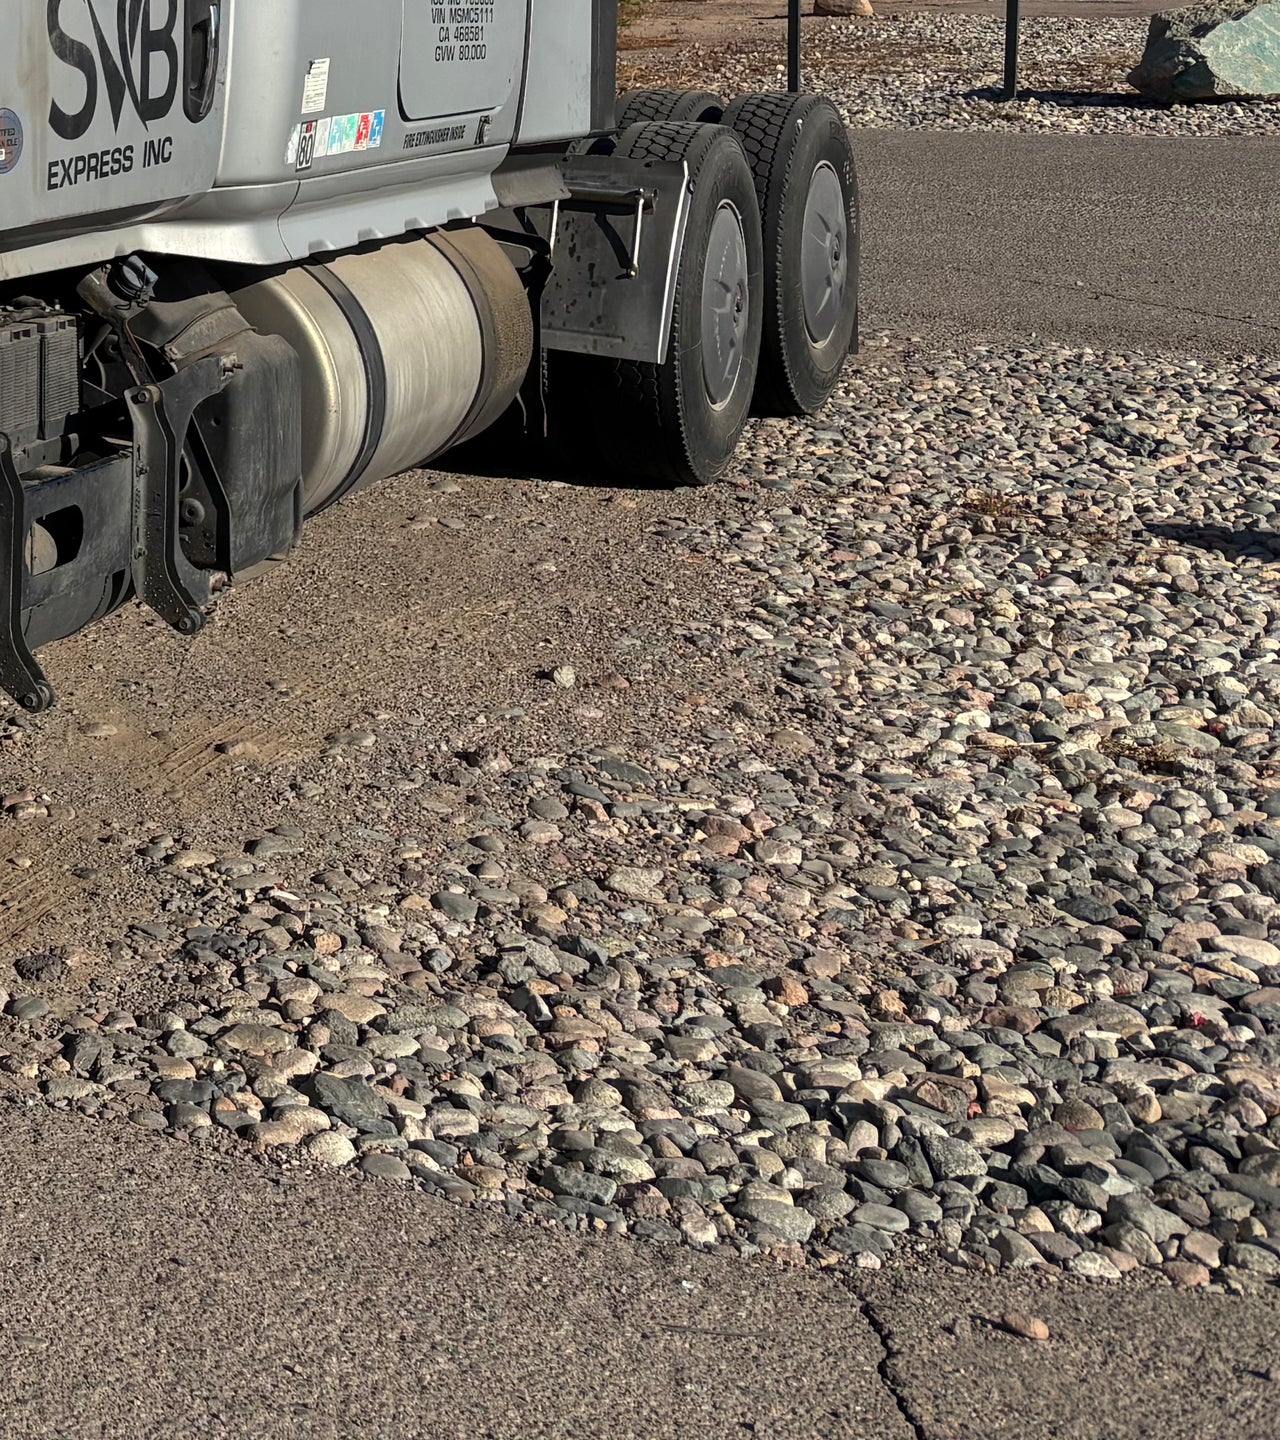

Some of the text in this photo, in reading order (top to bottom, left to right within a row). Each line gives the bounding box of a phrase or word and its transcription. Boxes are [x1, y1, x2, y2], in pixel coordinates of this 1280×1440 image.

[431, 7, 446, 24] VIN
[438, 26, 484, 42] CA 468581
[434, 45, 455, 62] GVW
[402, 132, 416, 149] FIRE
[299, 133, 313, 167] 80
[47, 136, 172, 191] EXPRESS INC
